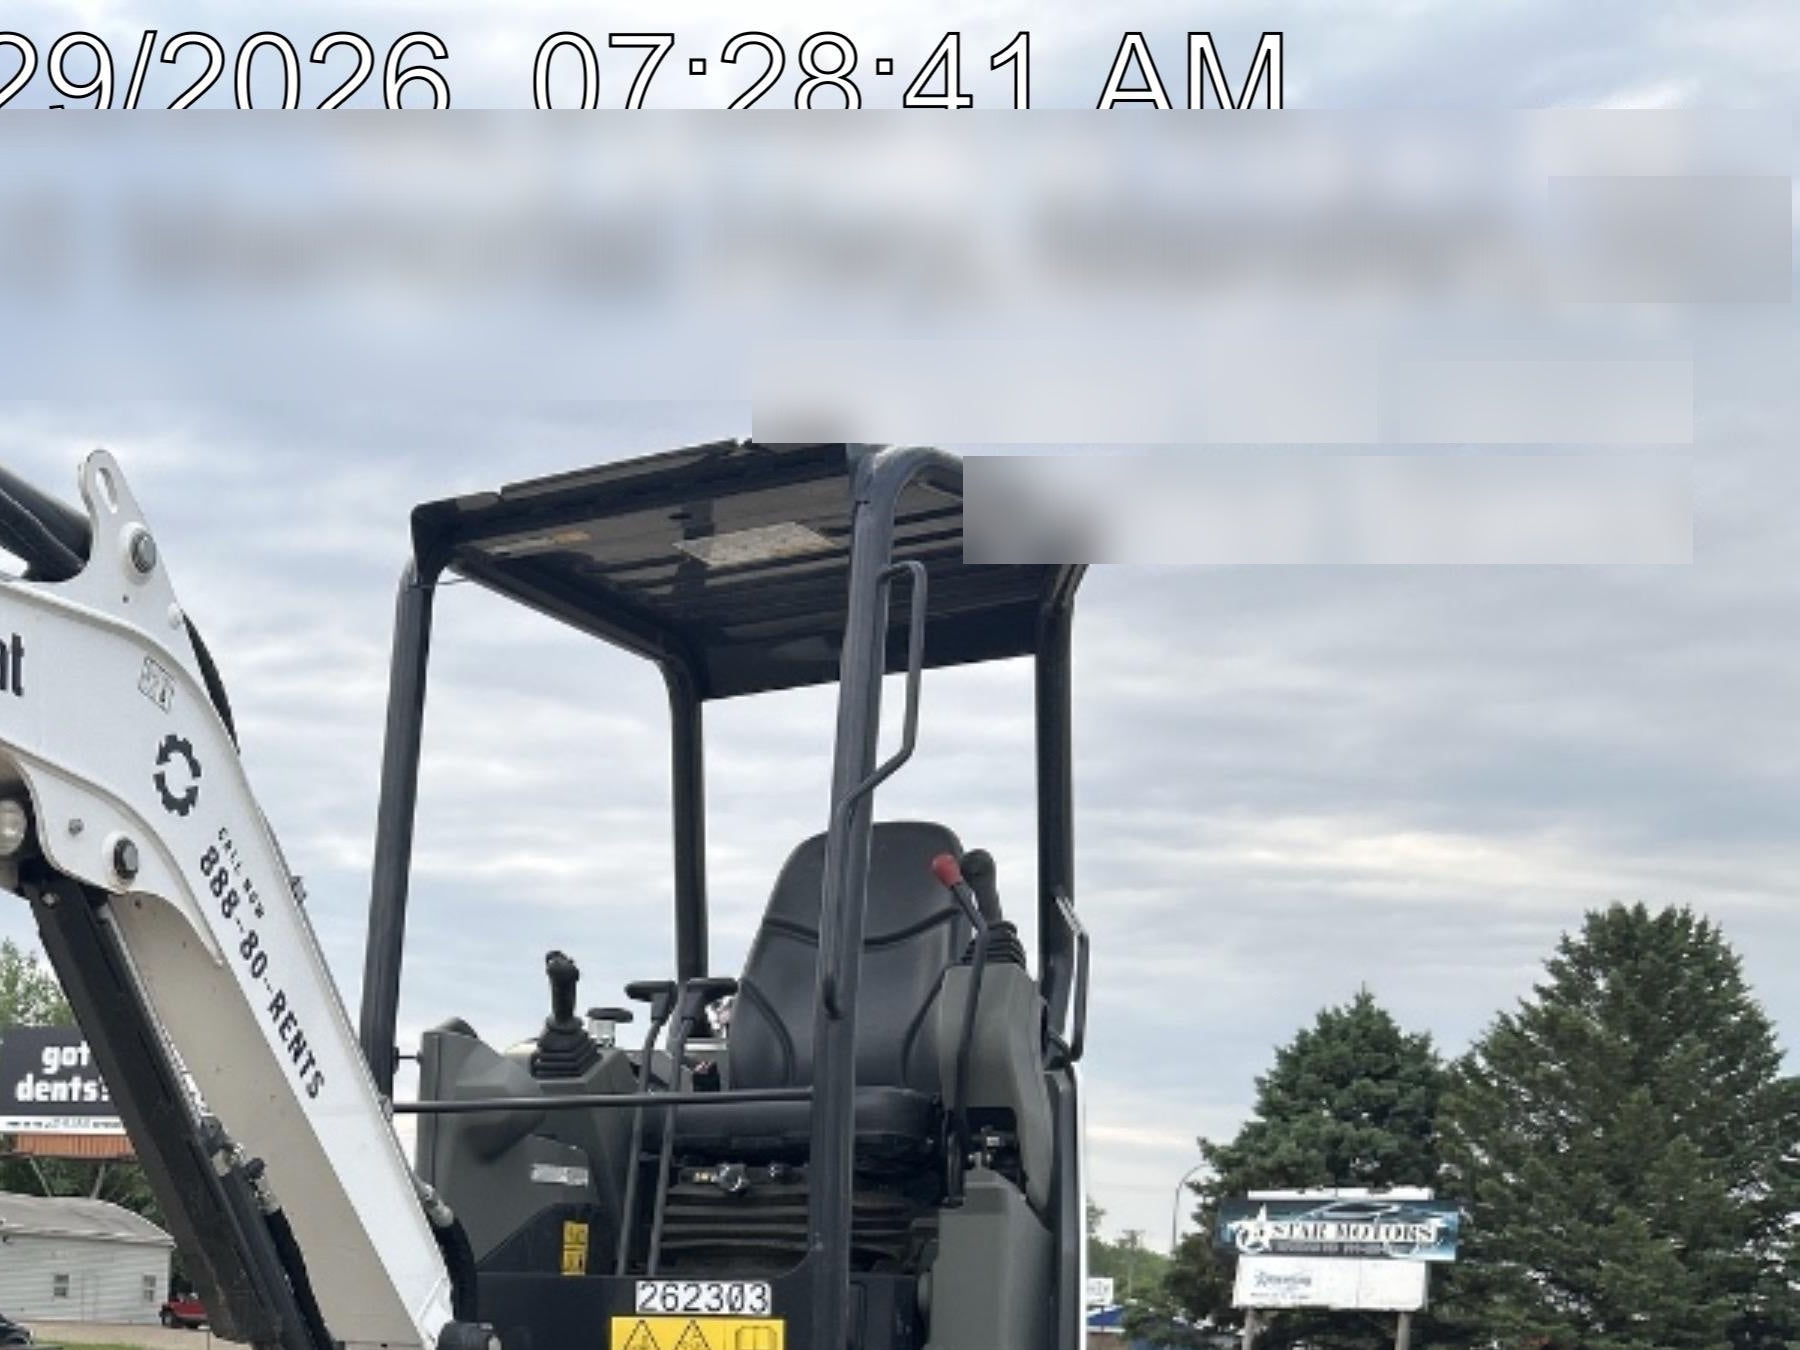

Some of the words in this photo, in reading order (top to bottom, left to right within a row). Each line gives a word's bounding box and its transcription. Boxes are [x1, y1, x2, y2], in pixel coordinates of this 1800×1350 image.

[41, 1040, 90, 1075] got
[1337, 1221, 1432, 1243] MOTORS
[639, 1283, 768, 1313] 262303
